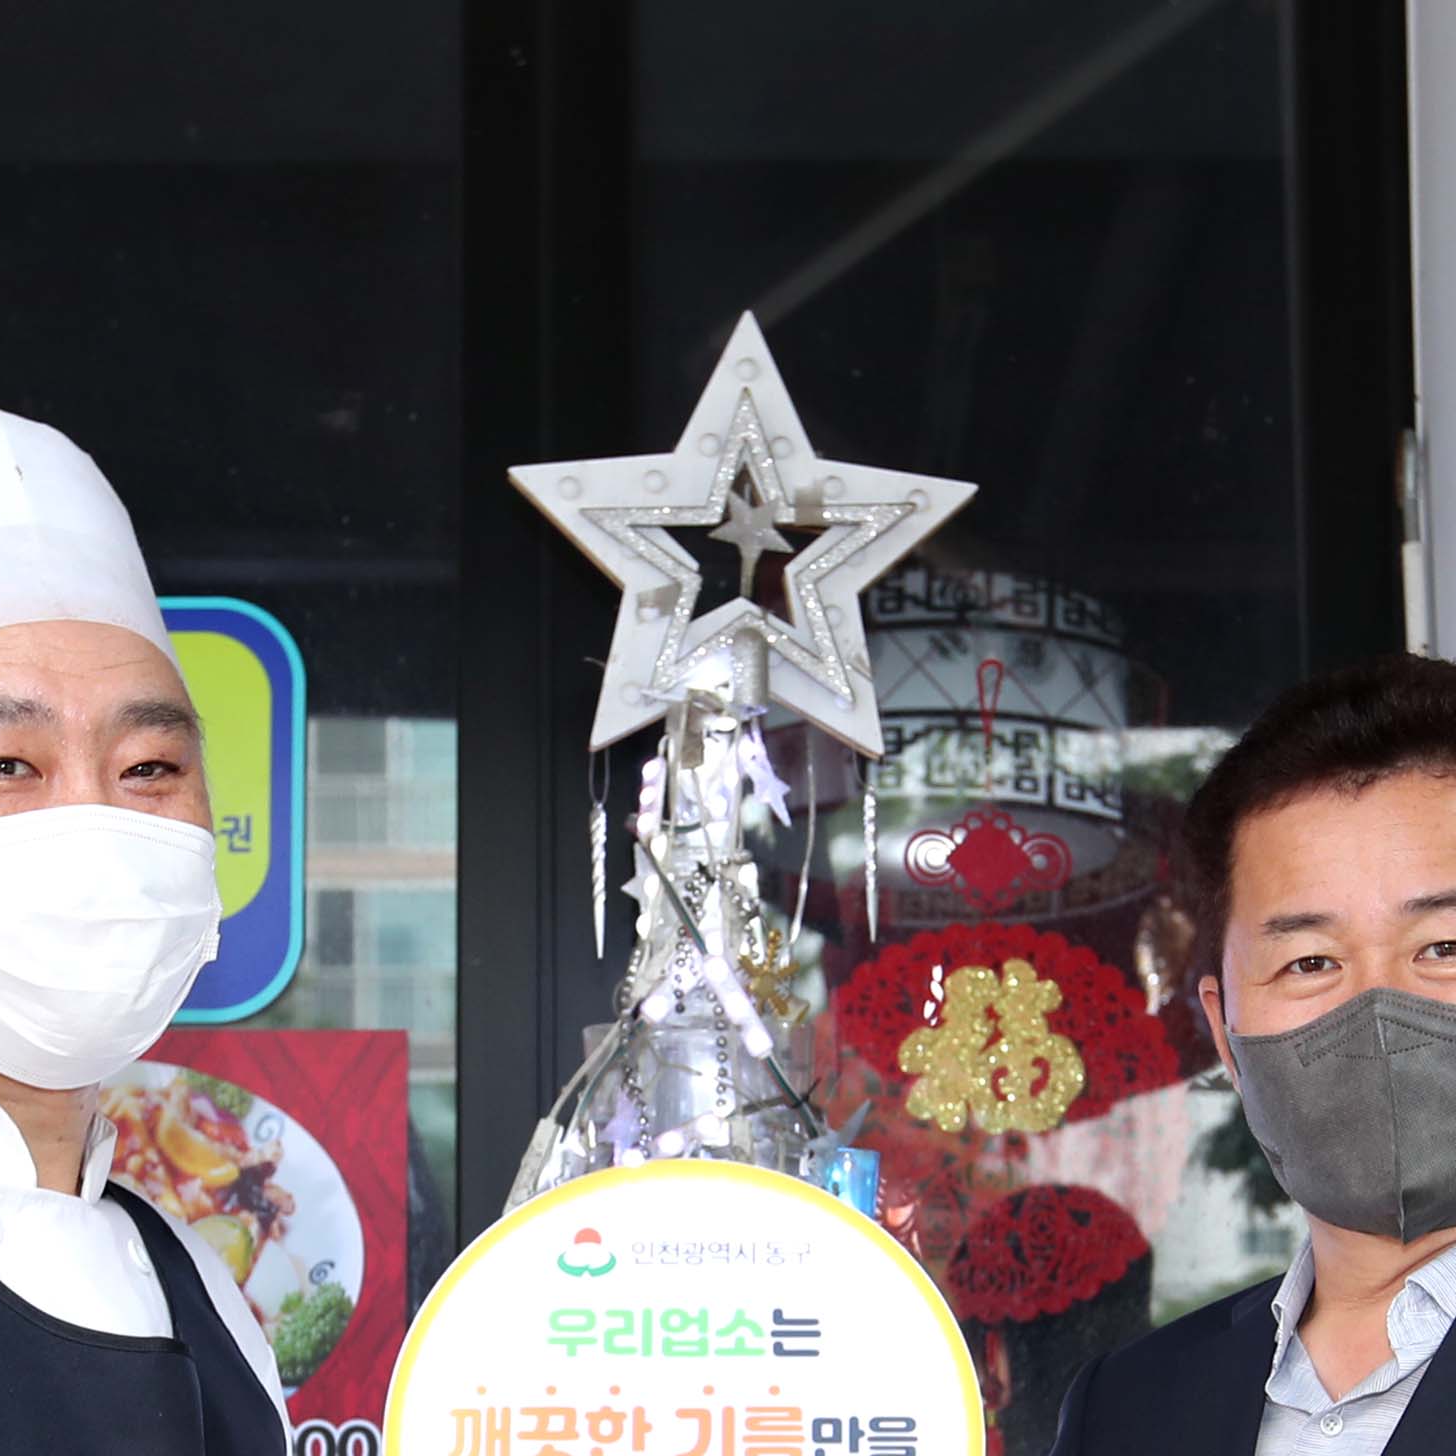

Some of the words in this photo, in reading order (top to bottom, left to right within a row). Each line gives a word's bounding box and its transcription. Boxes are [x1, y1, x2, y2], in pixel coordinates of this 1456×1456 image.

[215, 814, 253, 853] 권
[631, 1240, 757, 1265] 인천광역시
[547, 1308, 822, 1357] 우리업소는
